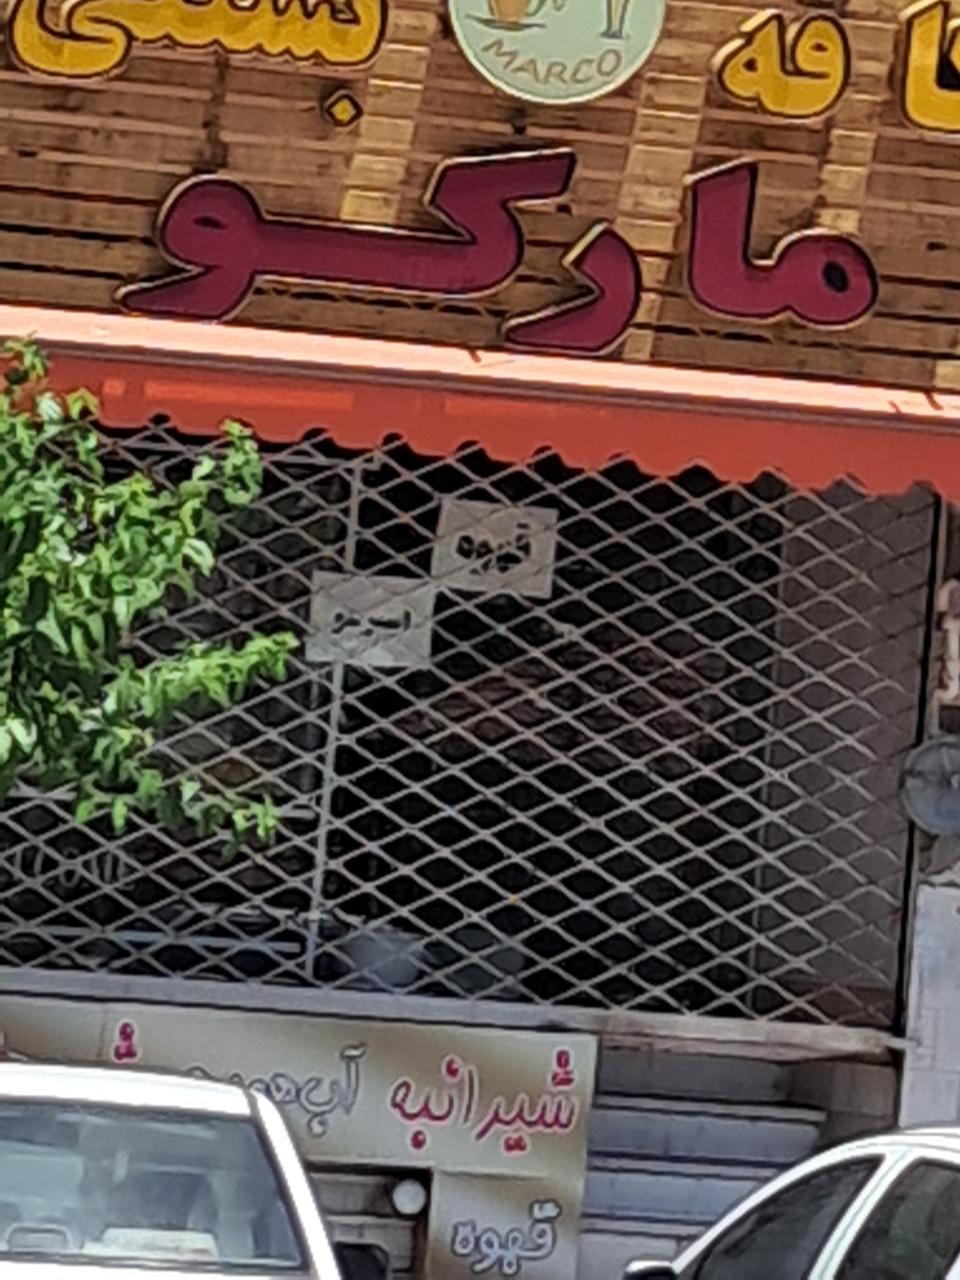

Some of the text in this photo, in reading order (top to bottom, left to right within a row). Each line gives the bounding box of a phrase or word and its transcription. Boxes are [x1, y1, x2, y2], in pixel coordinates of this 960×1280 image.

[481, 38, 623, 85] MARCO
[115, 147, 878, 355] مارکو
[452, 1198, 562, 1275] قهوه
